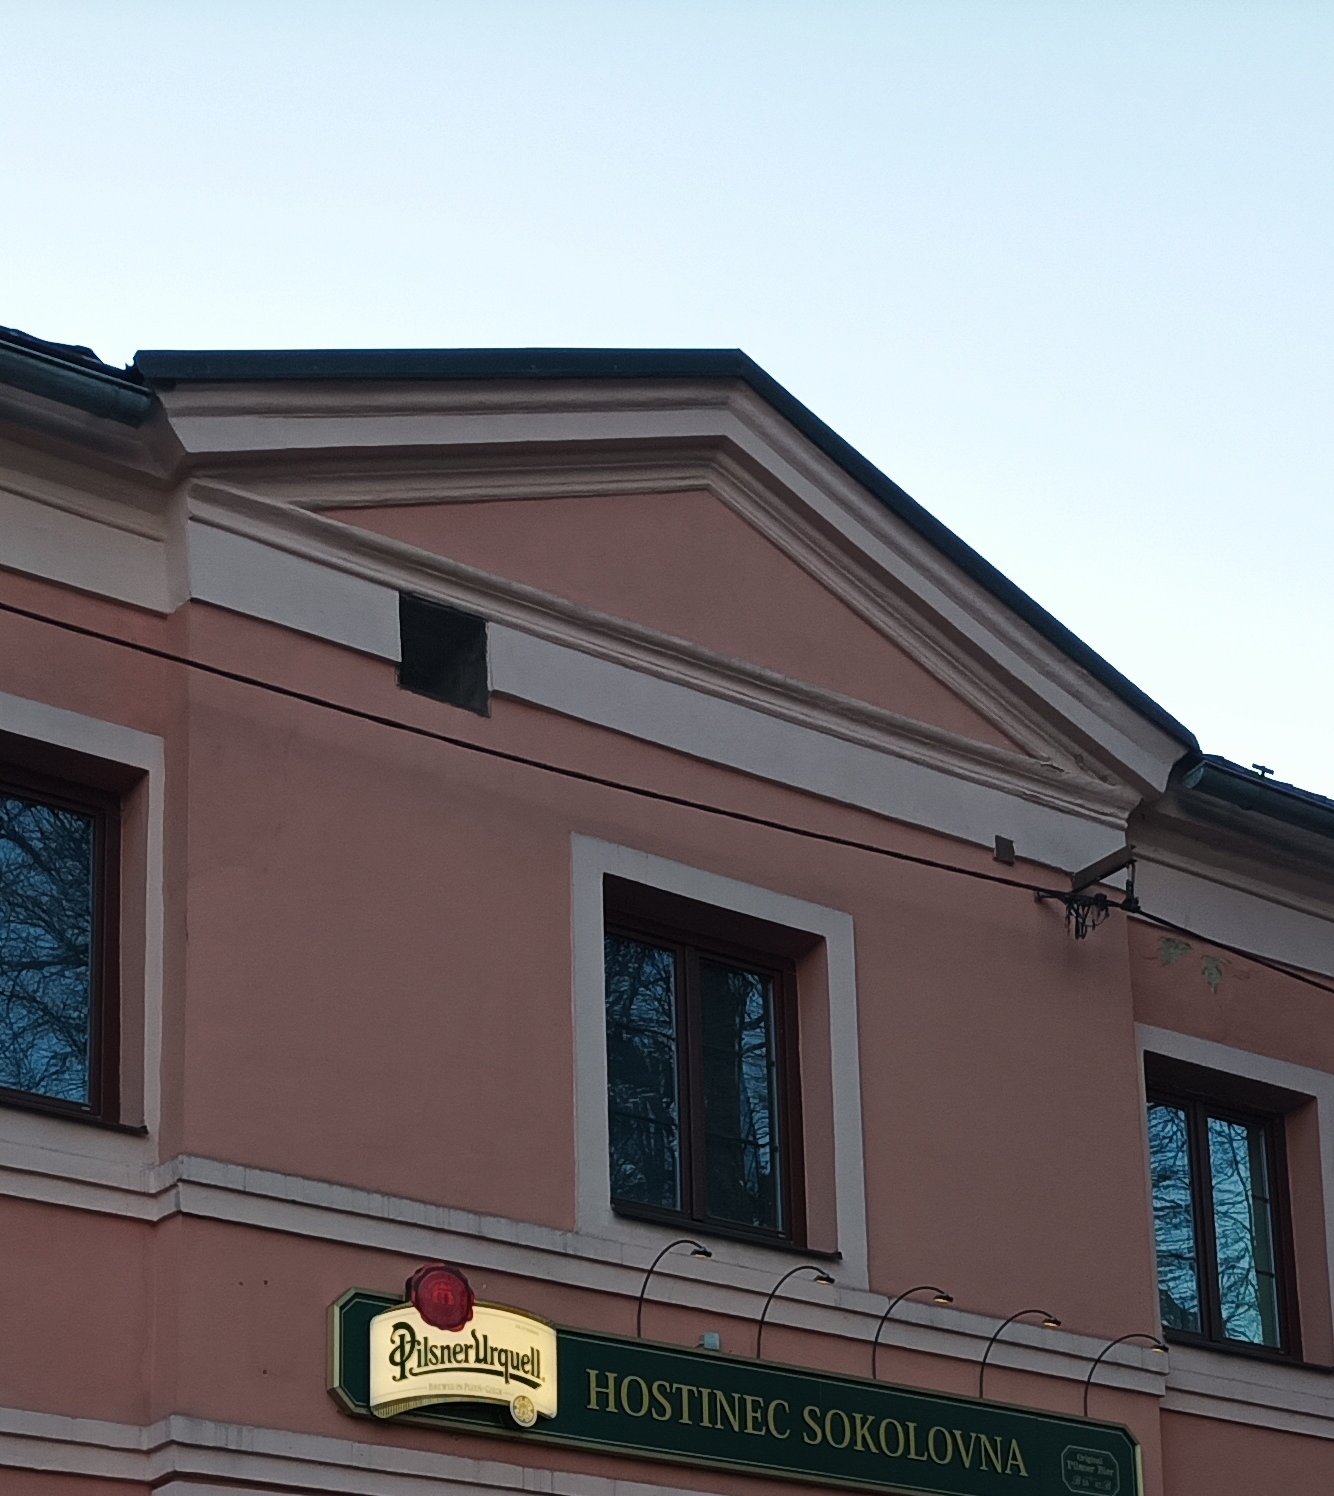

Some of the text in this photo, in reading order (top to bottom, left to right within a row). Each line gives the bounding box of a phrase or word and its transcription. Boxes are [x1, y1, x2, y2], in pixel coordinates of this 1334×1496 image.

[388, 1321, 541, 1385] Pilsner Urquell
[585, 1368, 1029, 1477] HOSTINEC SOKOLOVNA
